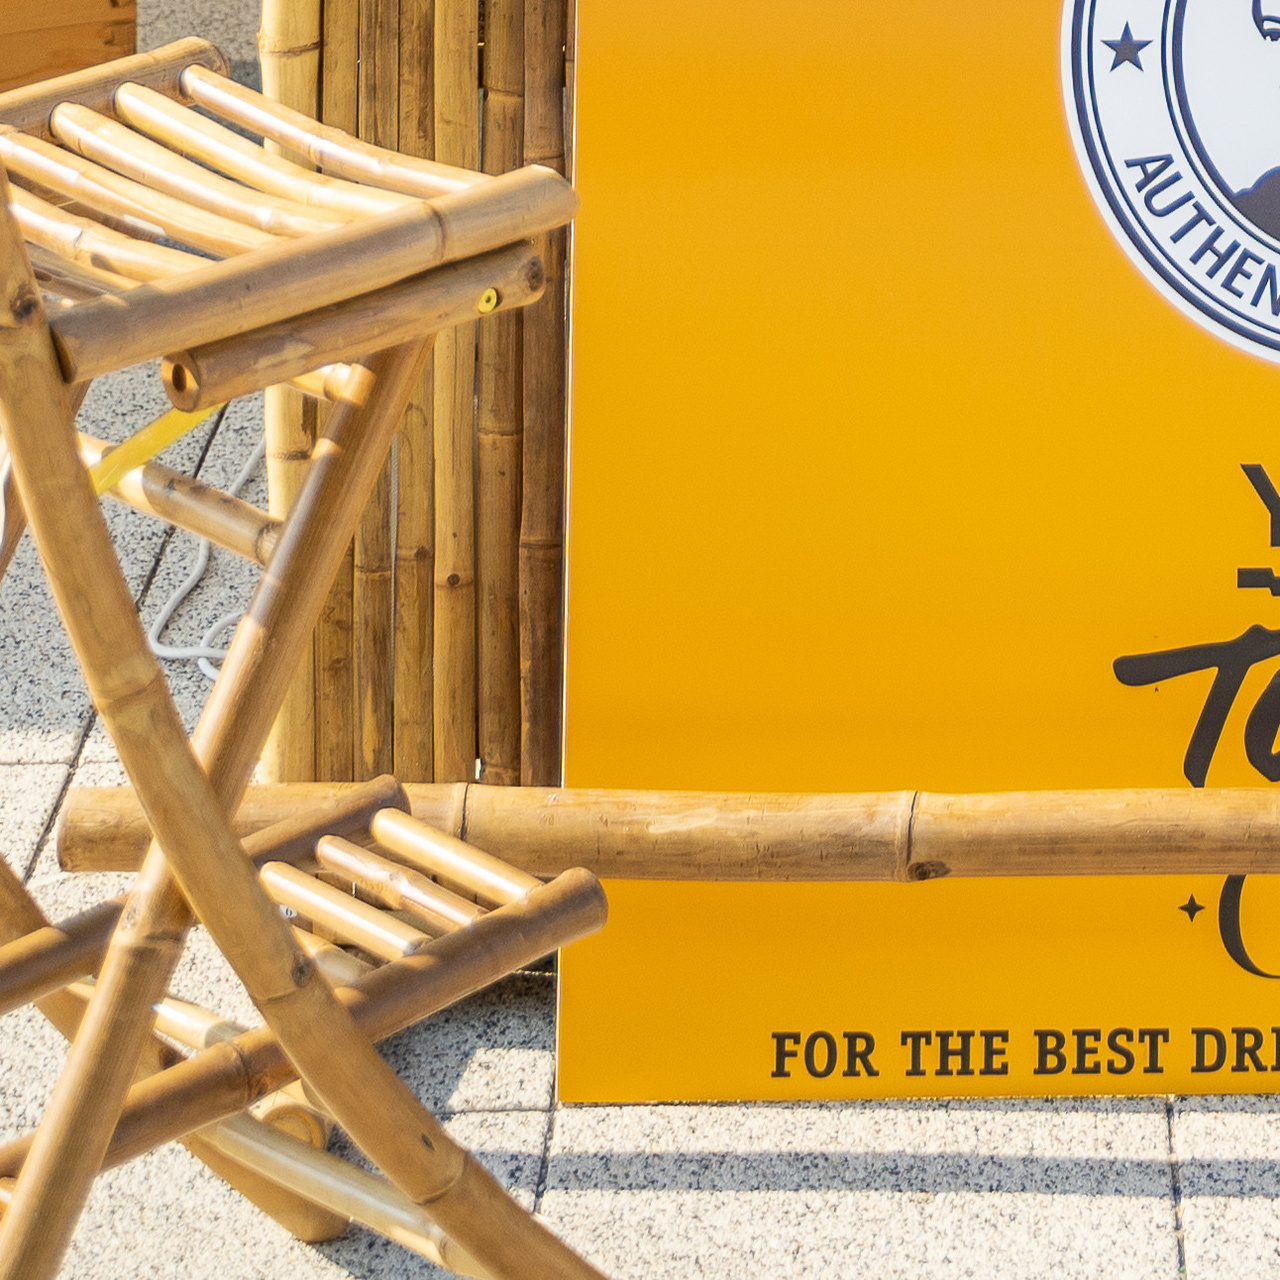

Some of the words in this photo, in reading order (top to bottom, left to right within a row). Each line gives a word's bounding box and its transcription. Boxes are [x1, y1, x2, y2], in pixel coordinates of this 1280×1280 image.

[770, 1031, 879, 1079] FOR
[901, 1030, 1009, 1077] THE
[1032, 1028, 1169, 1075] BEST
